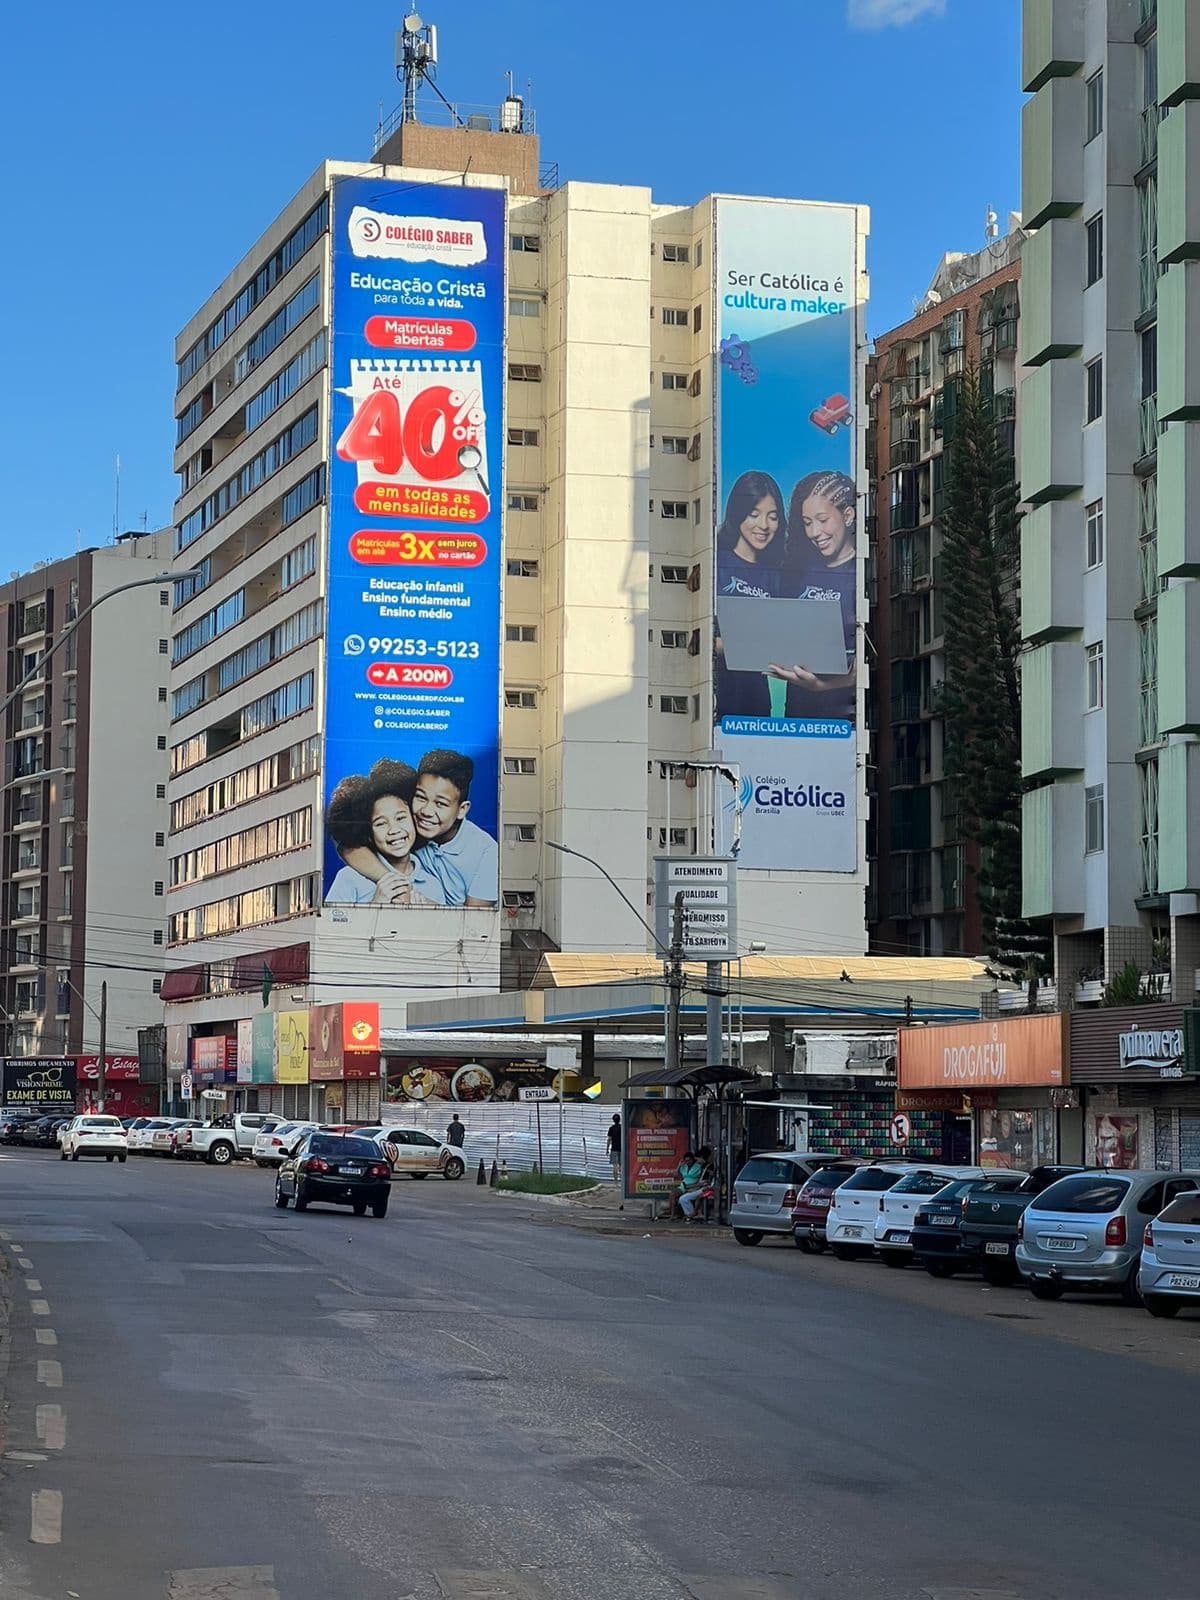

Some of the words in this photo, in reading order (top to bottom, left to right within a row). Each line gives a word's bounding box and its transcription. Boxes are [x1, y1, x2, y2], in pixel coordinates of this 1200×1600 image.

[385, 225, 434, 242] COLÉGIO
[436, 231, 473, 245] SABER
[406, 242, 435, 251] educação
[350, 273, 432, 296] Educação
[437, 278, 486, 297] Cristã
[728, 270, 755, 286] Ser
[760, 273, 829, 292] Católica
[834, 277, 844, 292] é
[374, 293, 398, 305] para
[400, 294, 426, 305] toda
[428, 298, 434, 306] a
[436, 297, 464, 309] vida.
[724, 291, 786, 311] cultura
[791, 296, 846, 315] maker
[385, 320, 453, 335] Matrículas
[394, 333, 445, 346] abertas
[372, 375, 402, 389] Até
[375, 486, 399, 498] em
[405, 487, 448, 502] todas
[453, 493, 471, 504] as
[368, 500, 476, 519] mensalidades
[399, 532, 435, 560] 3x
[456, 540, 477, 548] juros
[450, 551, 476, 560] cartão
[370, 578, 423, 593] Educação
[425, 580, 464, 593] infantil
[362, 592, 399, 604] Ensino
[400, 593, 470, 607] fundamental
[380, 606, 416, 618] Ensino
[418, 607, 453, 620] médio
[368, 637, 480, 659] 99253-5123
[386, 668, 399, 682] A
[402, 669, 448, 684] 200M
[385, 721, 449, 730] COLEGIOSABERDF
[725, 720, 796, 733] MATRÍCULAS
[799, 723, 848, 735] ABERTAS
[755, 776, 787, 785] Colégio
[755, 784, 845, 808] Católica
[674, 867, 723, 876] ATENDIMENTO
[680, 890, 719, 900] QUALIDADE
[1119, 1024, 1185, 1068] primavera
[7, 1090, 35, 1100] EXAME
[36, 1090, 47, 1100] DE
[49, 1090, 72, 1100] VISTA
[525, 1090, 549, 1099] ENTRADA
